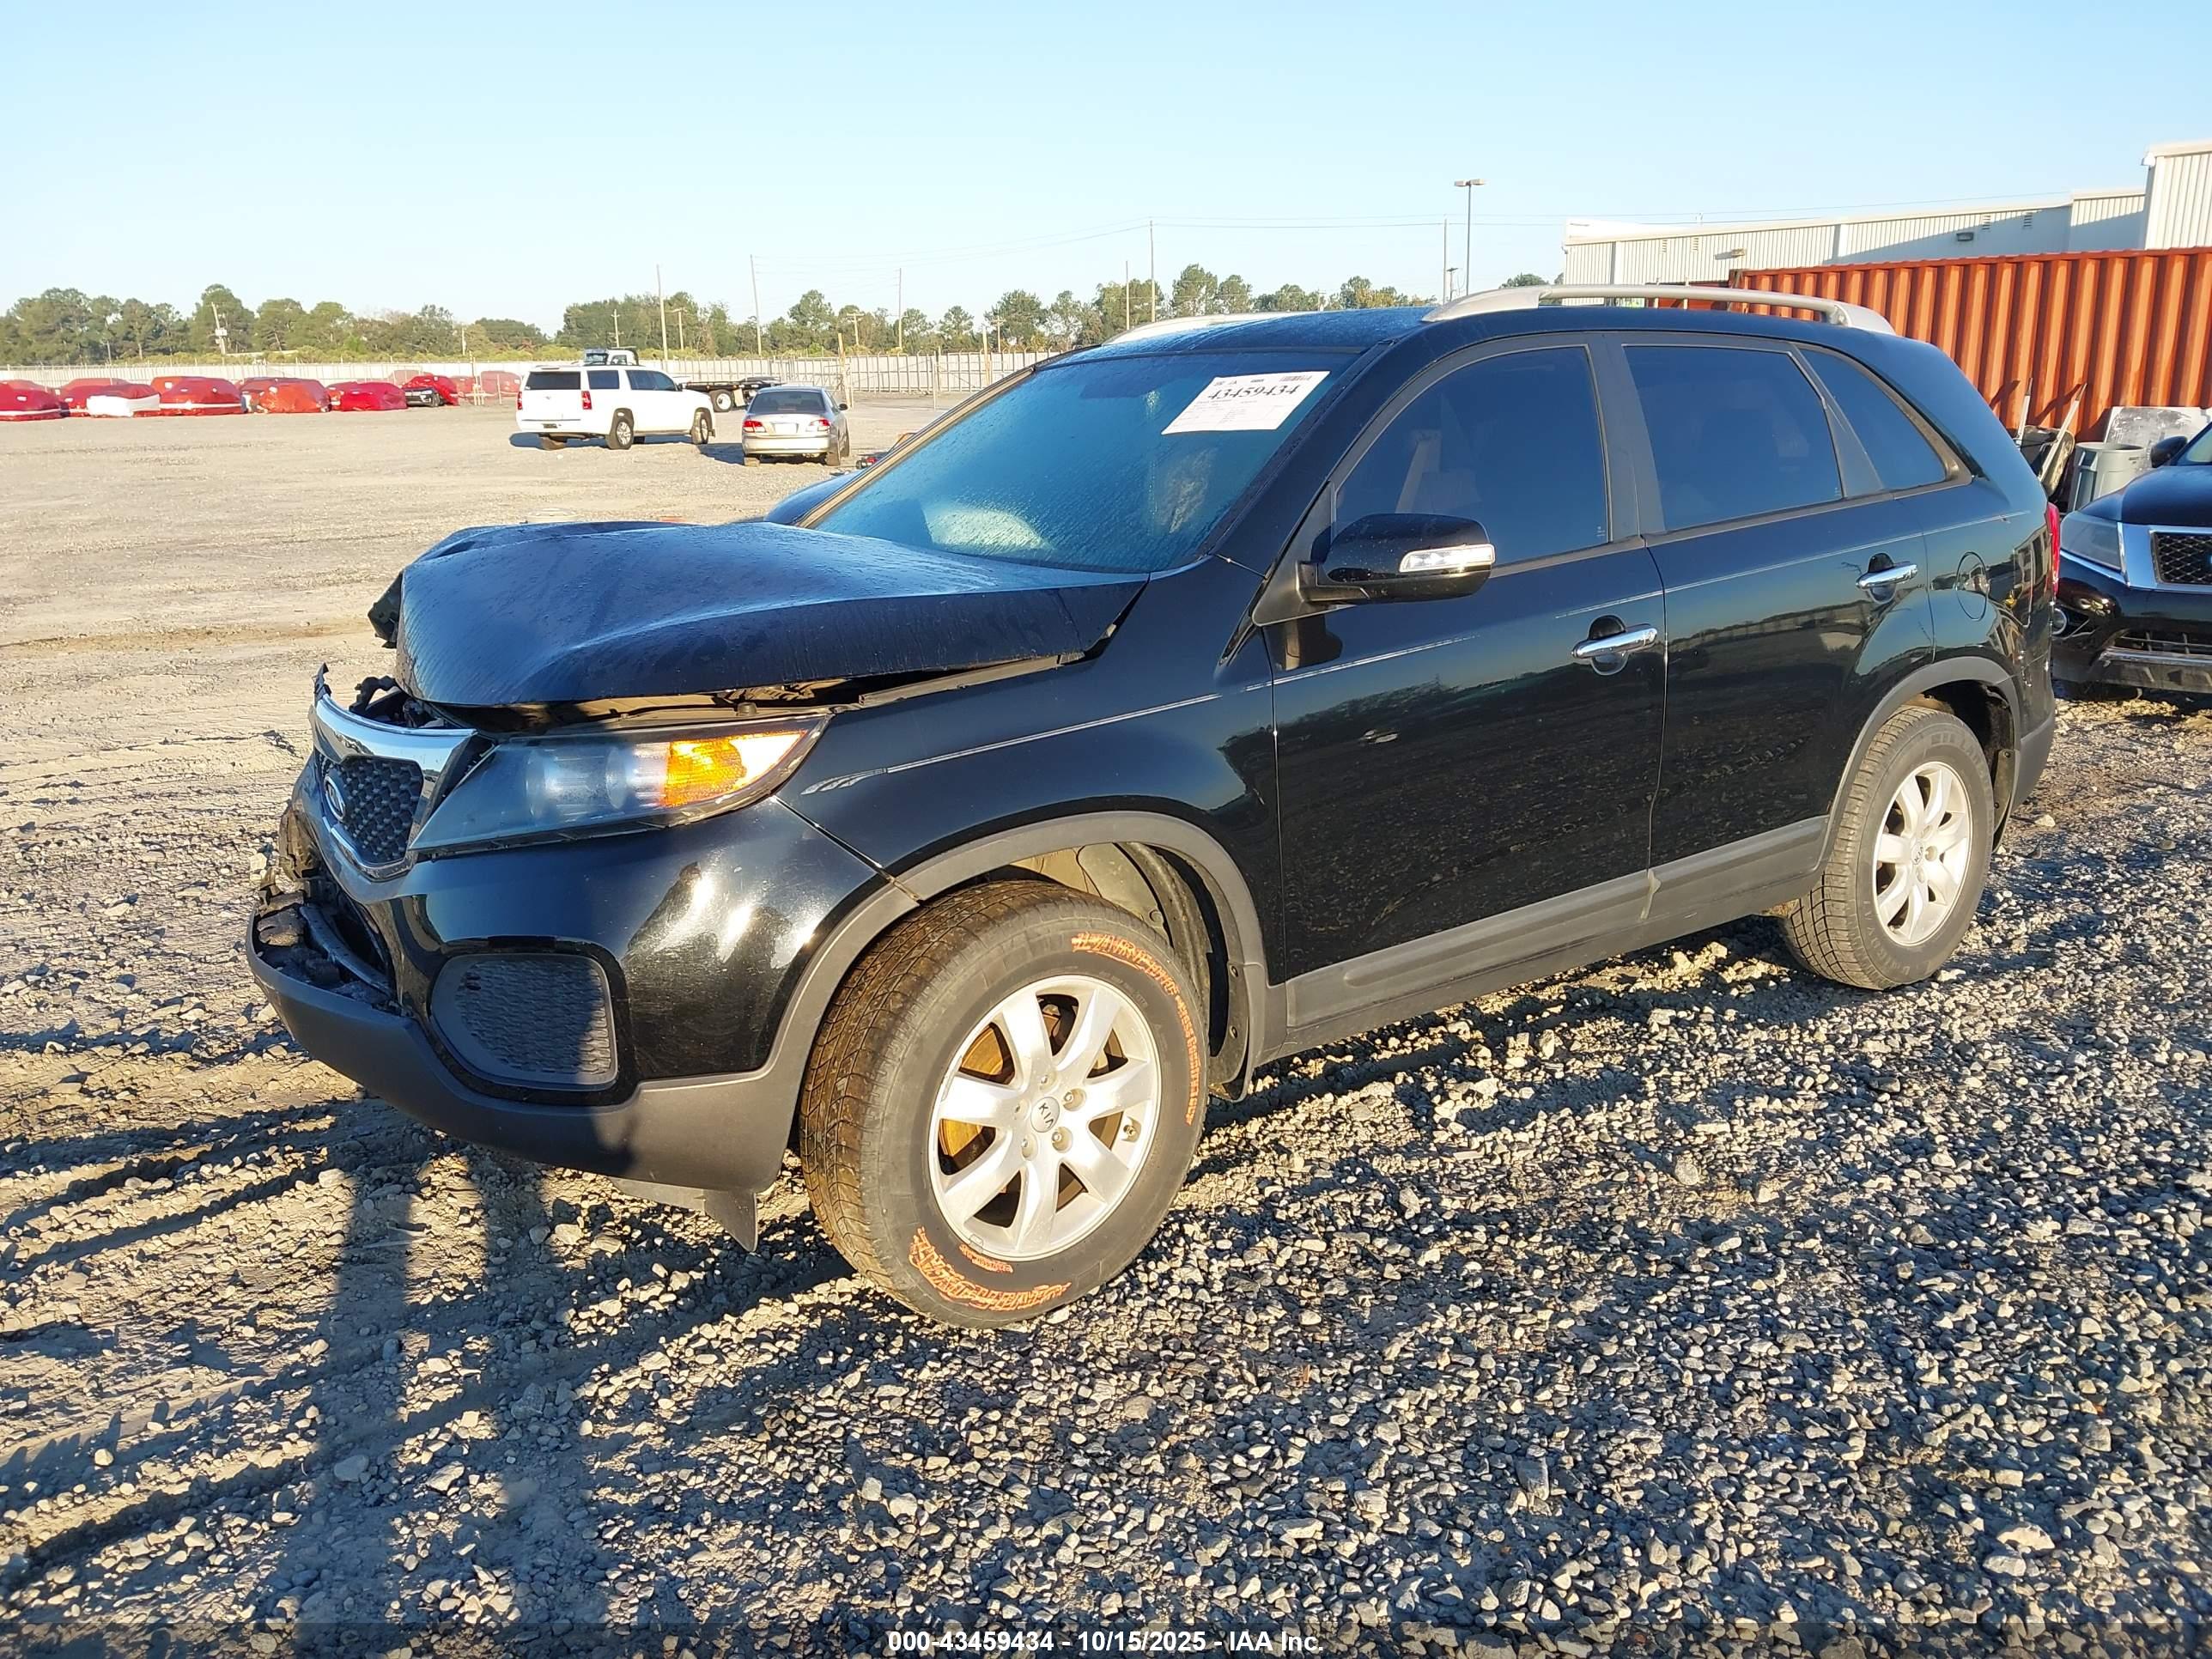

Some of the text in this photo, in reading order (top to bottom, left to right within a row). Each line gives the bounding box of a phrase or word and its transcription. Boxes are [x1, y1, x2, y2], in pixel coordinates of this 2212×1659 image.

[1208, 384, 1300, 399] 43459434
[1914, 845, 1924, 865] KIA
[1038, 1103, 1054, 1130] KIA
